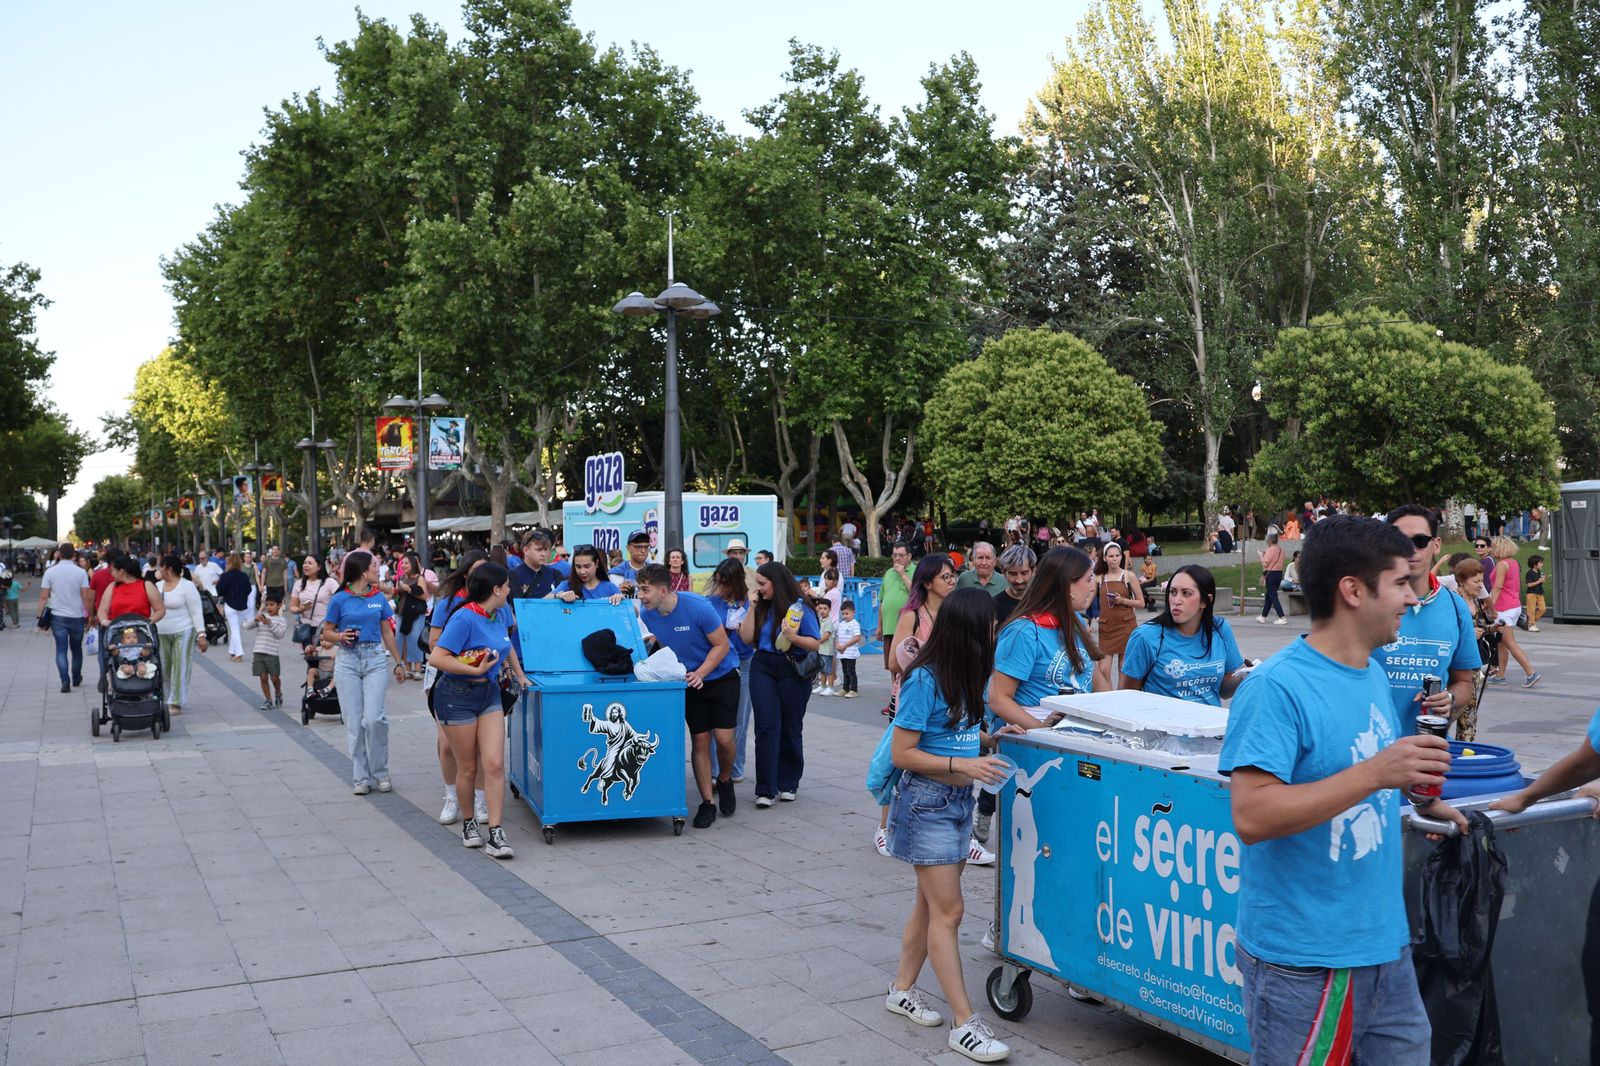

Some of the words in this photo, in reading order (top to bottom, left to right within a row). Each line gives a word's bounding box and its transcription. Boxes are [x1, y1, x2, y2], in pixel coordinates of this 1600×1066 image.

[586, 454, 623, 508] gaza
[700, 505, 739, 528] gaza
[1385, 656, 1439, 667] SECRETO
[1176, 676, 1218, 688] SECRETO
[1177, 685, 1211, 697] VIRIATO
[955, 733, 980, 742] VIRIA
[1095, 796, 1119, 864] el
[1133, 813, 1241, 894] secre
[1096, 877, 1134, 950] de
[1144, 879, 1244, 988] viria
[1139, 986, 1235, 1036] @SecretodViriato
